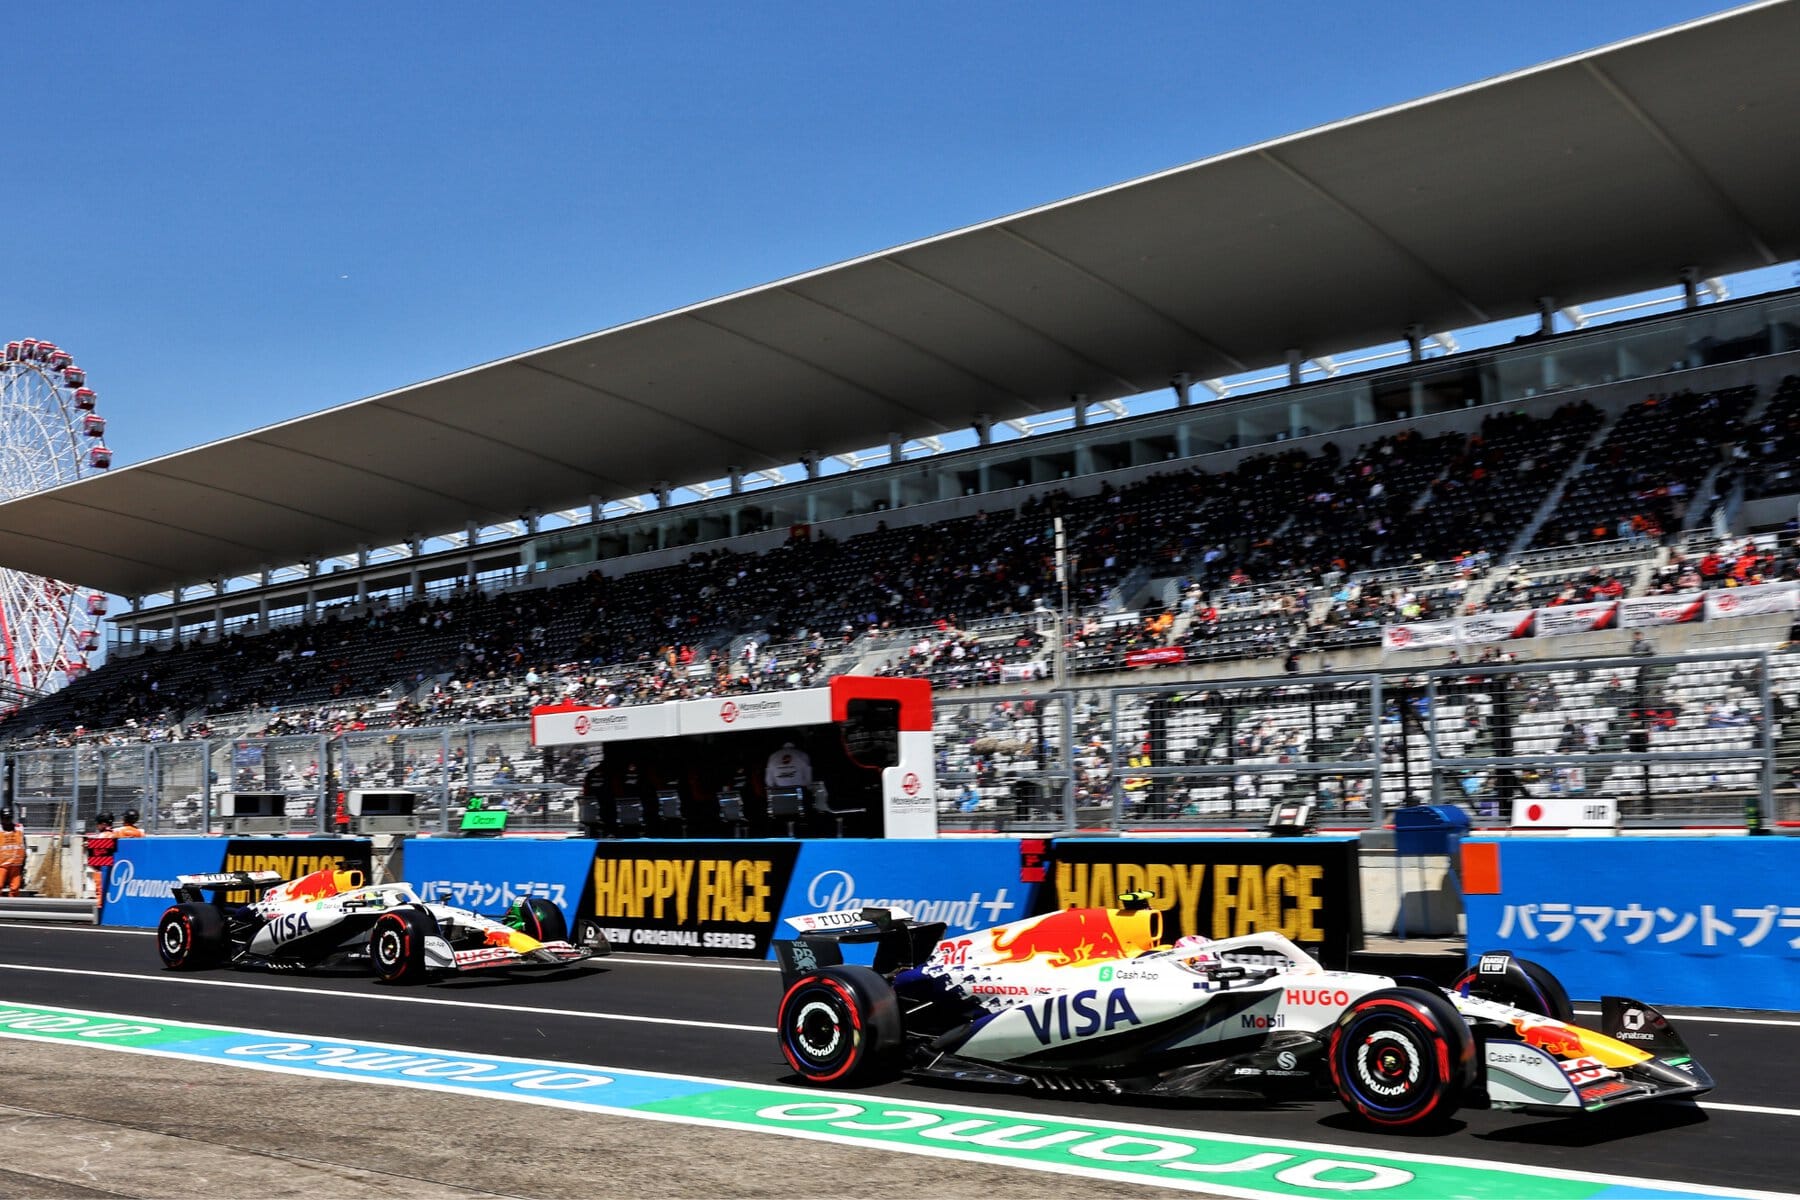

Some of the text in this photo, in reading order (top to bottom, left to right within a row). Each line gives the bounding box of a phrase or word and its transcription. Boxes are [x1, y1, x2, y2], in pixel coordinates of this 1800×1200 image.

[594, 857, 772, 925] HAPPY FACE
[1211, 863, 1325, 941] FACE
[818, 912, 863, 926] TUDO
[268, 911, 313, 945] VISA
[632, 929, 701, 947] ORIGINAL
[703, 932, 756, 949] SERIES
[1116, 970, 1159, 981] Cash App
[972, 985, 1029, 995] HONDA
[1286, 990, 1349, 1007] HUGO
[1016, 988, 1142, 1045] VISA
[1241, 1014, 1285, 1028] Mobil
[1616, 1031, 1655, 1041] dynatrace
[1488, 1051, 1542, 1066] Cash App
